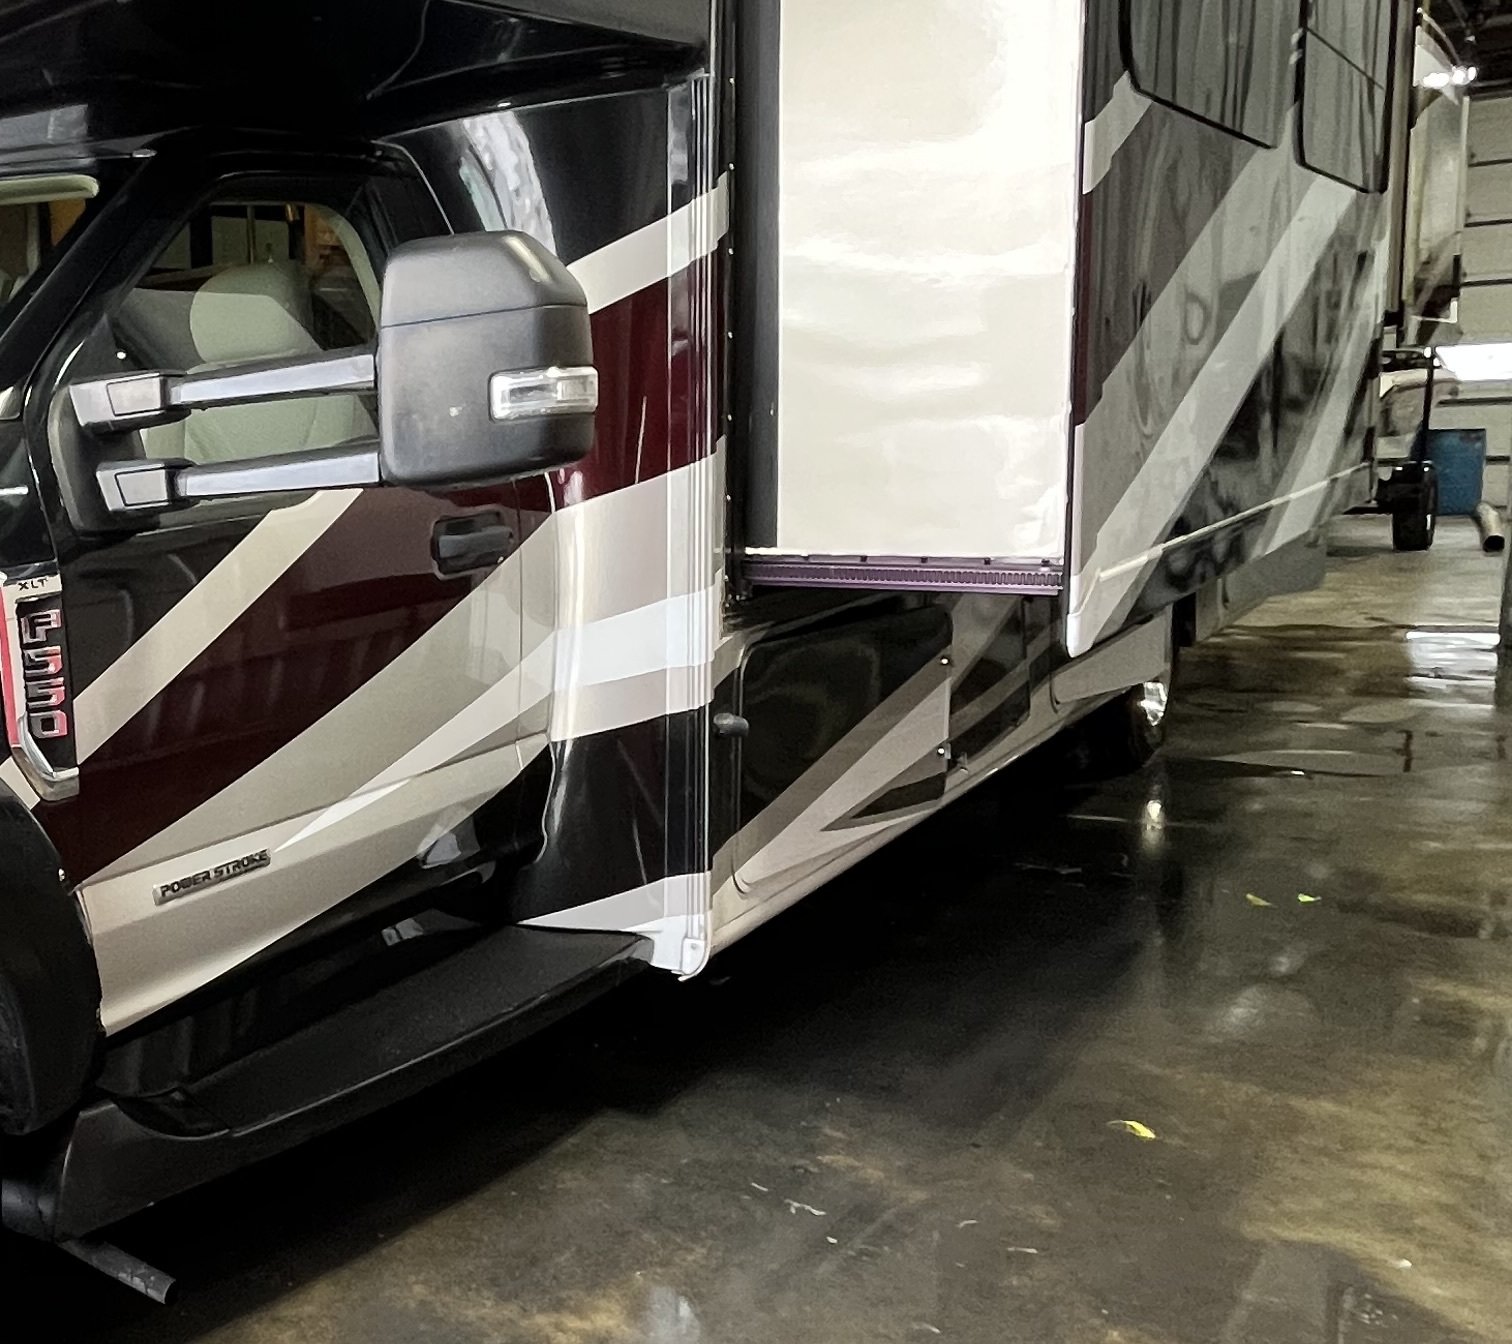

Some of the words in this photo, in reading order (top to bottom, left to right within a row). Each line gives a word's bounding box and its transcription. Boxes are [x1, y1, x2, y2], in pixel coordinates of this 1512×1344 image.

[17, 577, 49, 591] XLT
[20, 609, 68, 739] F550
[159, 869, 212, 898] POWER
[213, 848, 269, 875] STROKE
